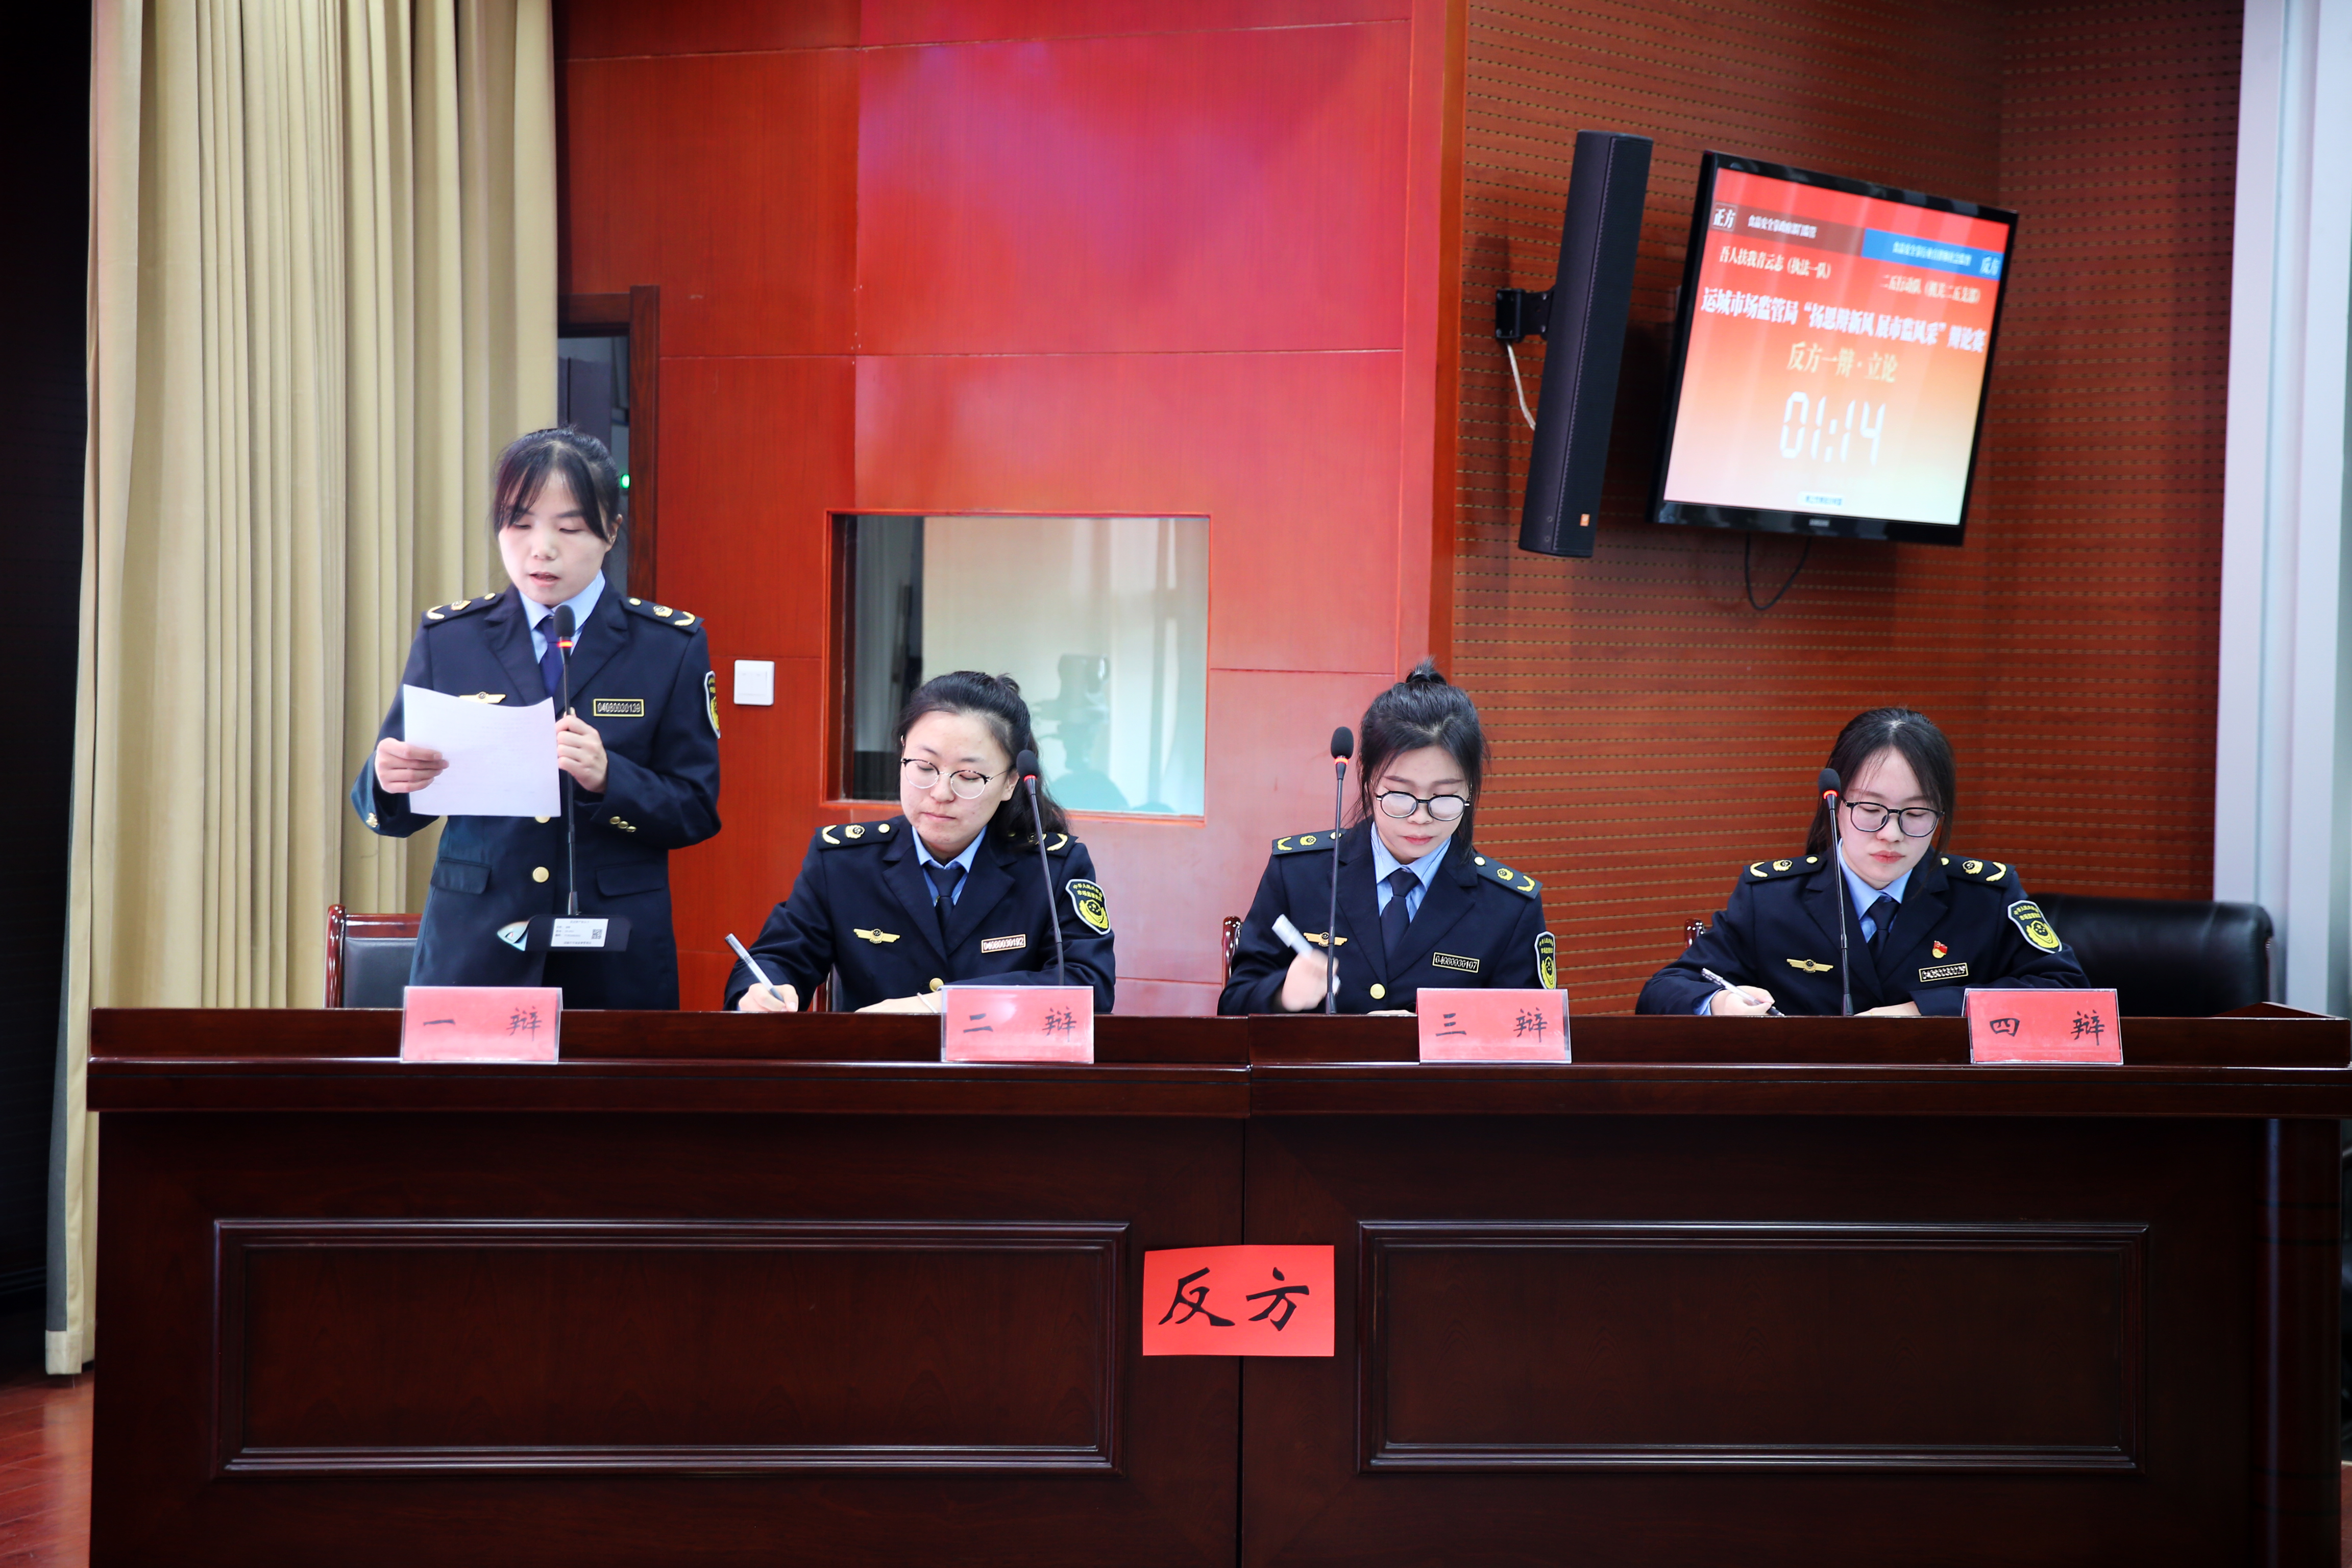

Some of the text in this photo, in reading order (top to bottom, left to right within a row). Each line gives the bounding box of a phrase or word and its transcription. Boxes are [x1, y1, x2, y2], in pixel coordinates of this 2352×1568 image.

[1712, 208, 1736, 229] 正方
[1779, 391, 1886, 467] 01:14
[1435, 955, 1478, 970] 04080030107
[1158, 1266, 1310, 1332] 反方
